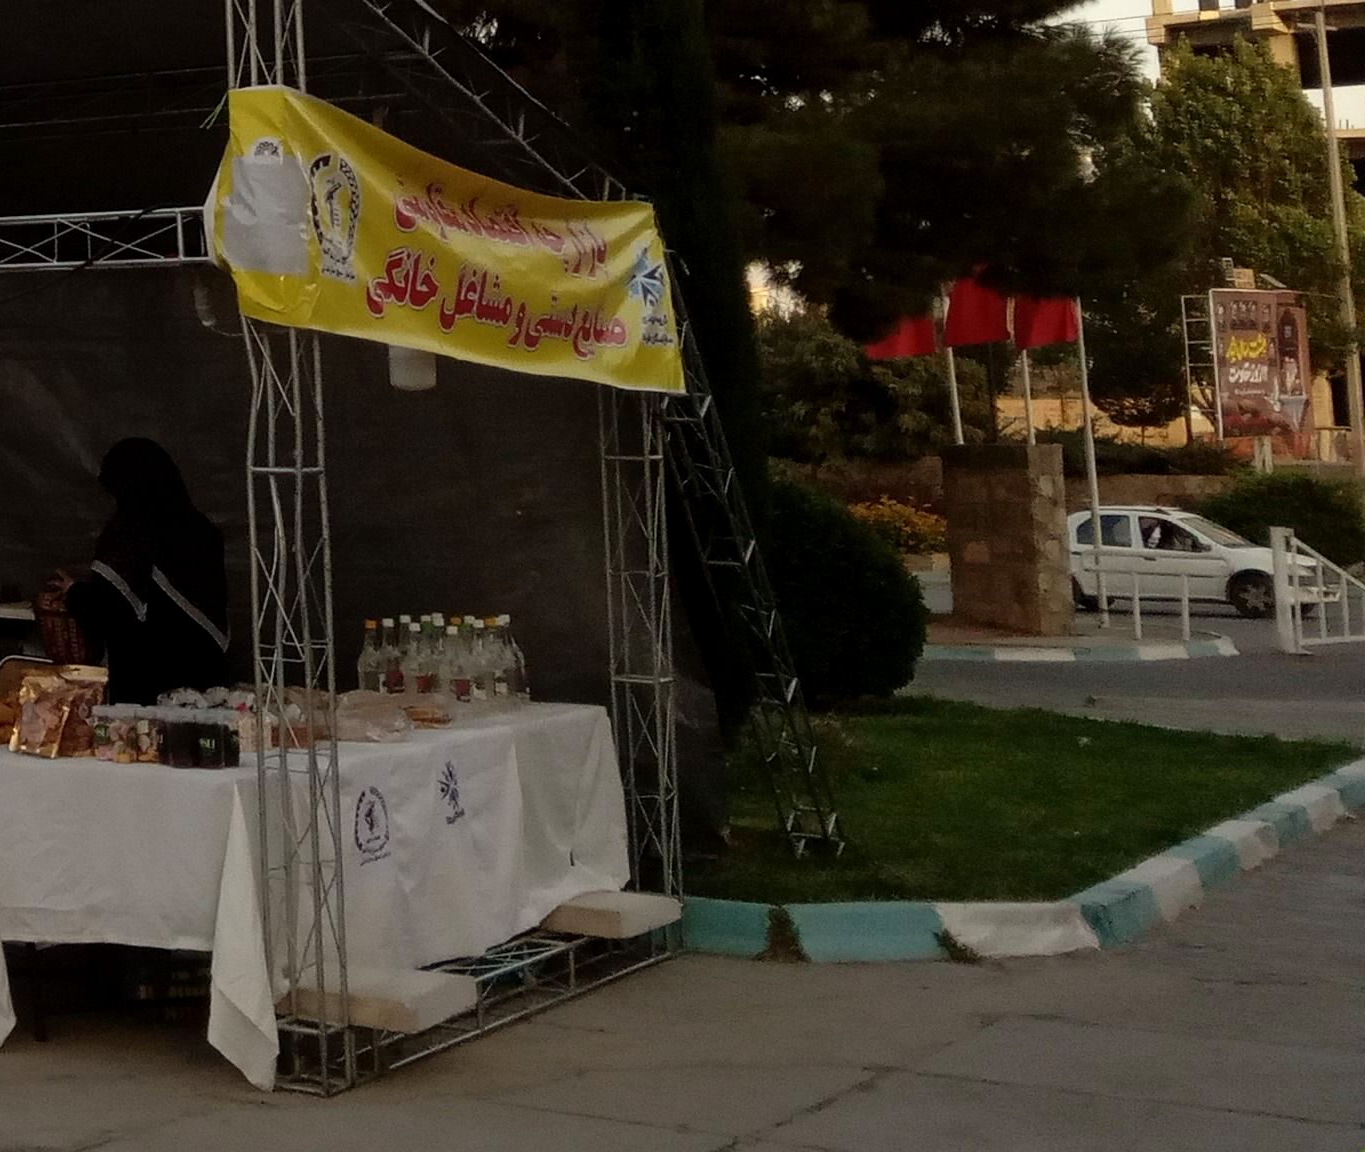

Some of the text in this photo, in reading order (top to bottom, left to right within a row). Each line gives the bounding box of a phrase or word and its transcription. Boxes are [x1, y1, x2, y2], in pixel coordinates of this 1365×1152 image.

[365, 246, 630, 361] صنایع دستی و مشاغل خانگی
